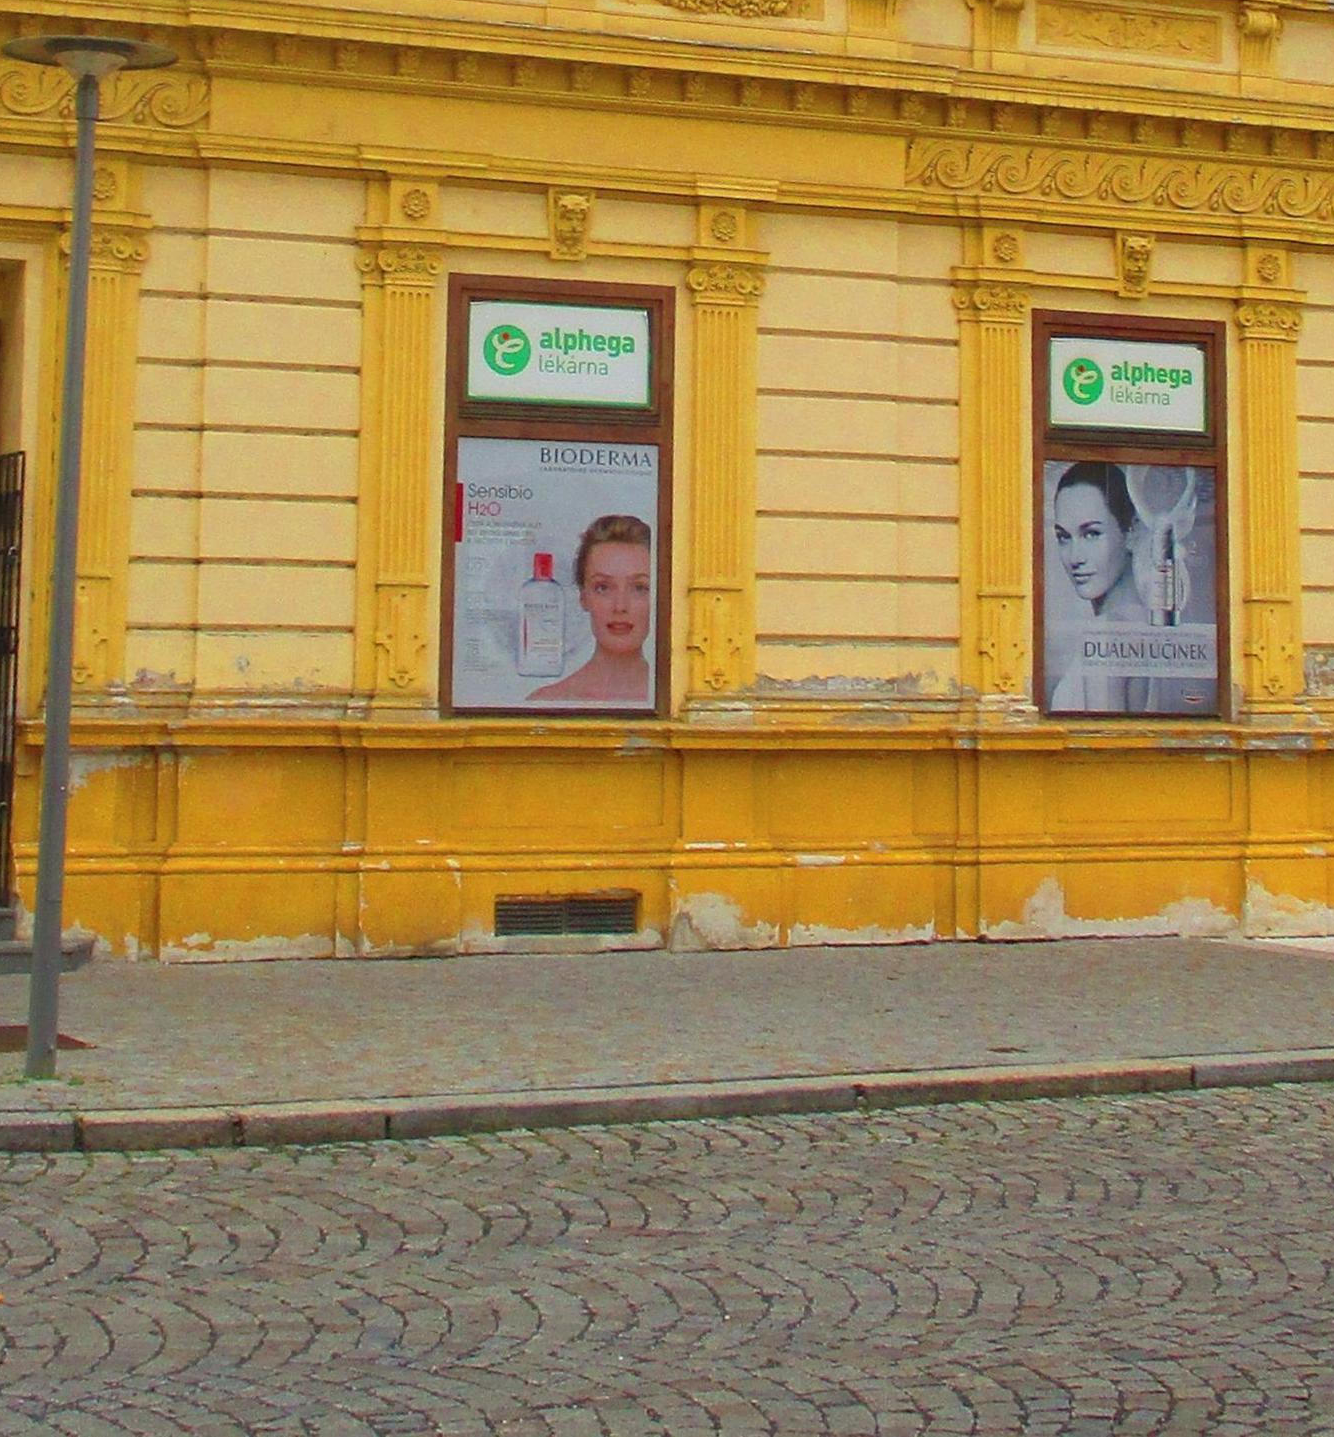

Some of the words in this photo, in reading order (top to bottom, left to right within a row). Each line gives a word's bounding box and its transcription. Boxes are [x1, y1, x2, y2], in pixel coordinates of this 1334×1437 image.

[539, 327, 635, 357] alphega
[538, 355, 608, 376] lékárna
[1110, 361, 1193, 389] alphega
[1110, 386, 1171, 406] lékárna
[540, 447, 652, 468] BIODERMA
[468, 483, 533, 500] Sensibio
[468, 501, 501, 517] H2O
[1083, 637, 1145, 659] DUÁLNÍ
[1149, 639, 1208, 661] ÚČINEK
